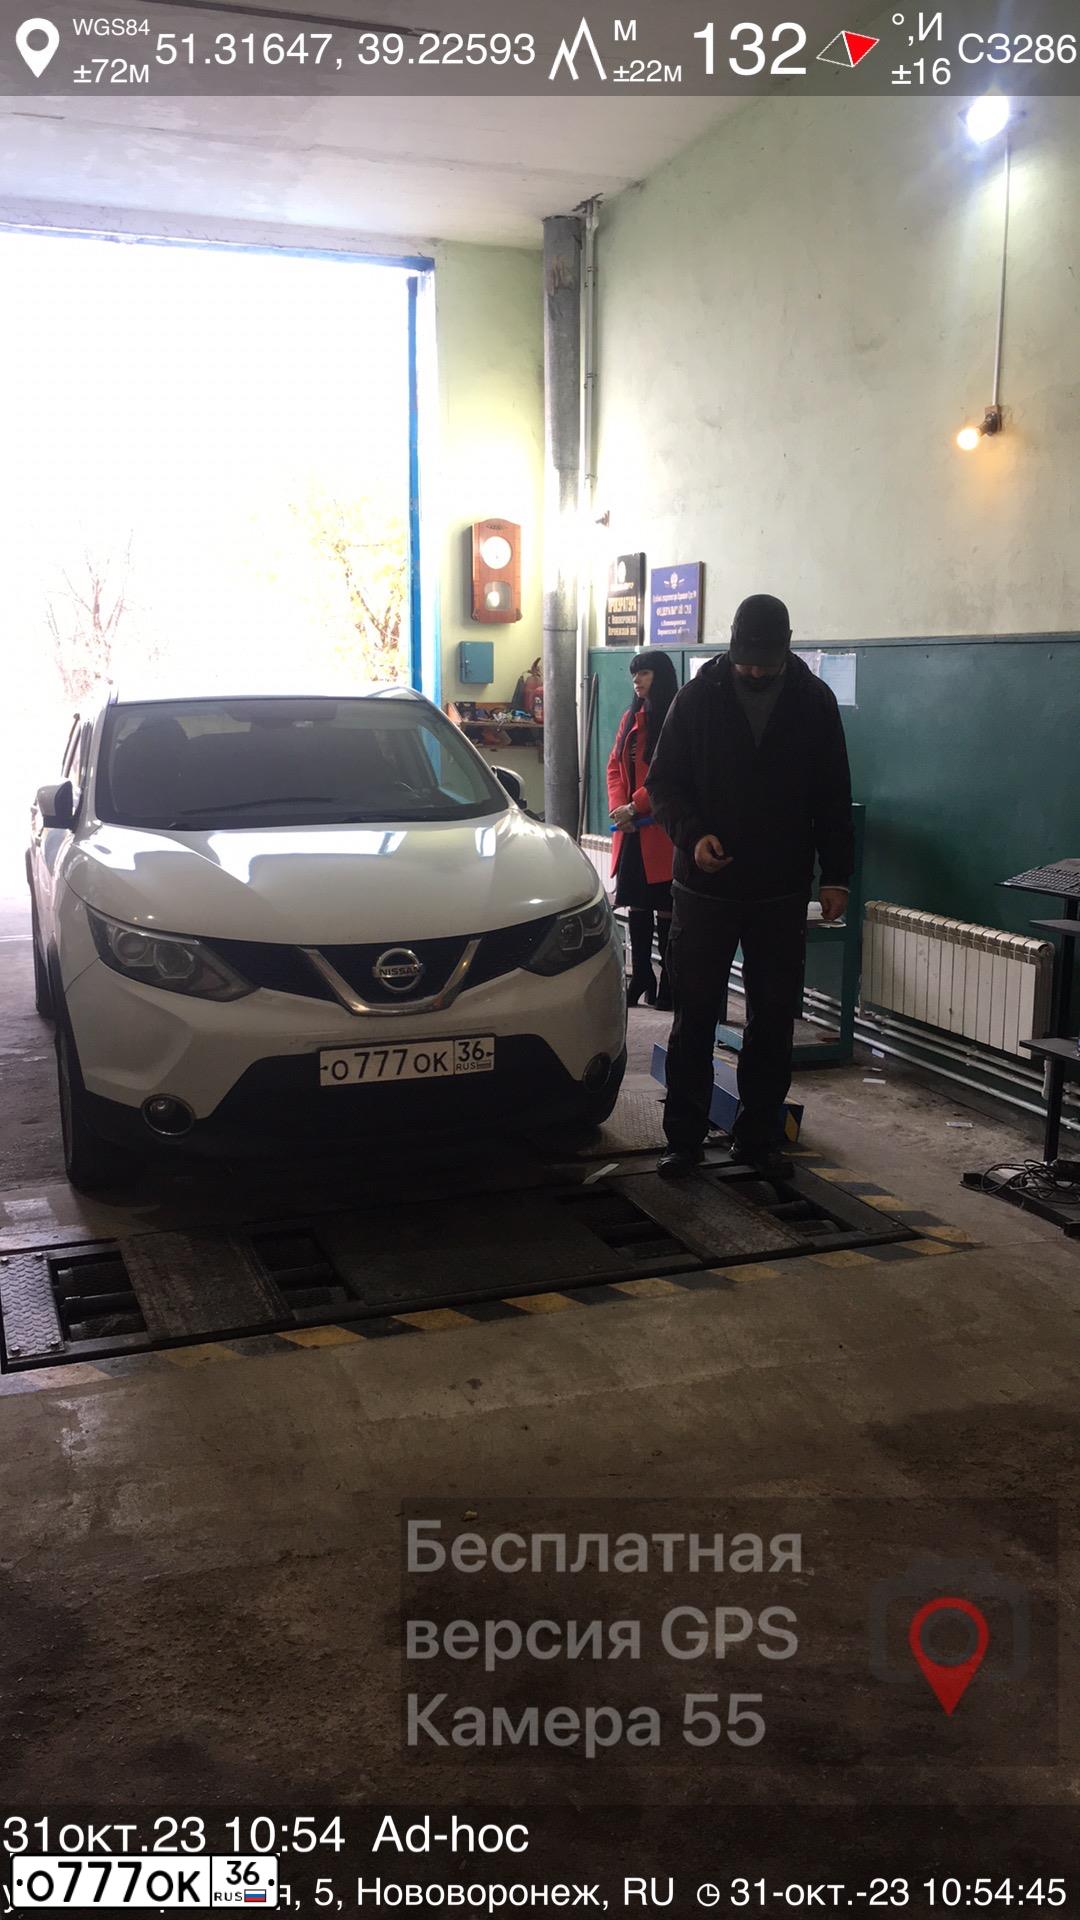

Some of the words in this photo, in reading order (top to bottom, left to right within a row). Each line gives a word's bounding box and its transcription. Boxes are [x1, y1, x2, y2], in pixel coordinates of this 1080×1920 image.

[379, 967, 421, 977] NISSAN
[458, 1041, 484, 1062] 36
[456, 1062, 476, 1071] RUS
